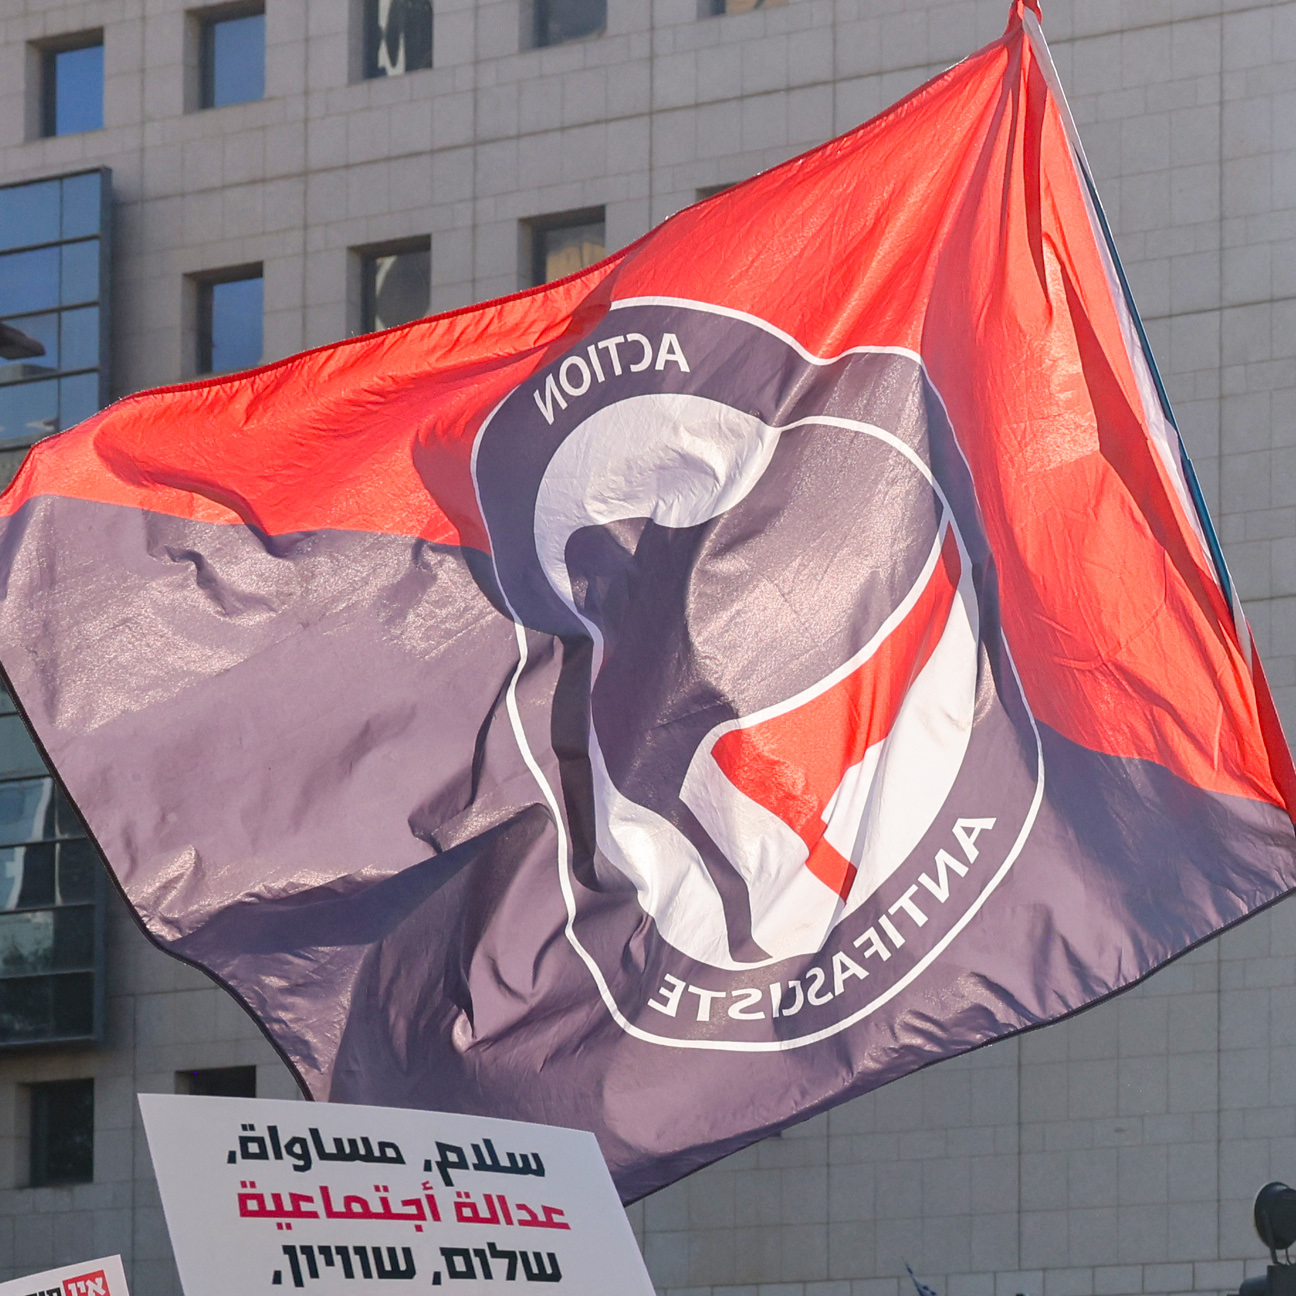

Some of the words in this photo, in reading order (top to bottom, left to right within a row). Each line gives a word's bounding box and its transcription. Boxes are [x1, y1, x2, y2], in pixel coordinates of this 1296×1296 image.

[237, 1180, 442, 1233] أجتماعية
[454, 1190, 572, 1231] عدالة
[271, 1244, 417, 1288] שוויון,
[431, 1242, 563, 1287] שלום,
